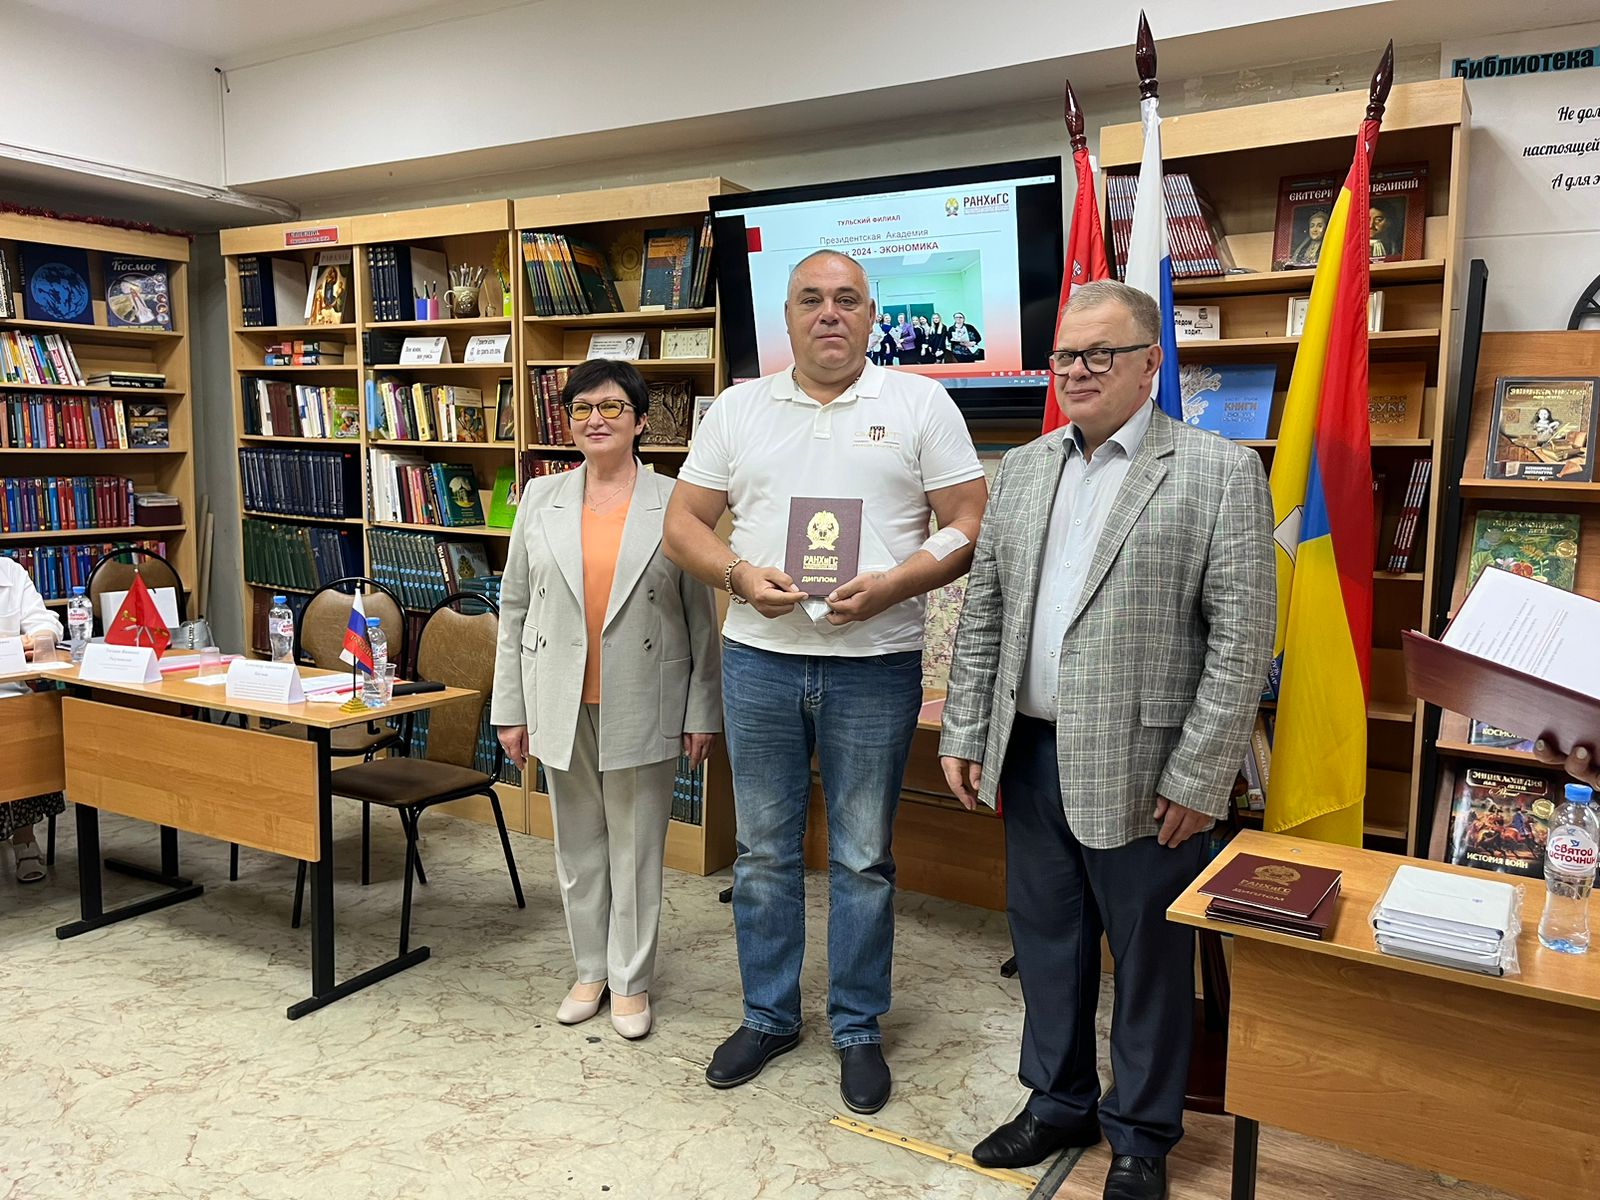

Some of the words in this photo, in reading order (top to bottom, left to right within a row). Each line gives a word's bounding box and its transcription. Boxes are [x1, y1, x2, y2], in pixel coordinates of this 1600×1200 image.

[1454, 49, 1594, 79] Библиотека
[1558, 106, 1574, 121] Не
[1523, 137, 1600, 157] настоящей
[1372, 177, 1419, 193] ВЕЛИКИЙ
[1552, 173, 1563, 190] А
[1565, 175, 1591, 191] для
[963, 192, 1009, 208] РАНХиГС
[837, 216, 871, 226] ТУЛЬСКИЙ
[872, 214, 901, 223] ФИЛИАЛ
[819, 233, 881, 245] Президентская
[886, 229, 929, 239] Академия
[852, 248, 872, 257] 2024
[879, 241, 939, 254] ЭКОНОМИКА
[112, 260, 157, 272] Космос
[803, 555, 839, 565] РАНХиГС
[801, 575, 837, 583] ДИПЛОМ
[1482, 727, 1520, 738] КОСМО
[1554, 844, 1593, 857] СВЯТОЙ
[1466, 852, 1504, 865] ИСТОРИЯ
[1505, 859, 1529, 869] ВОЙН
